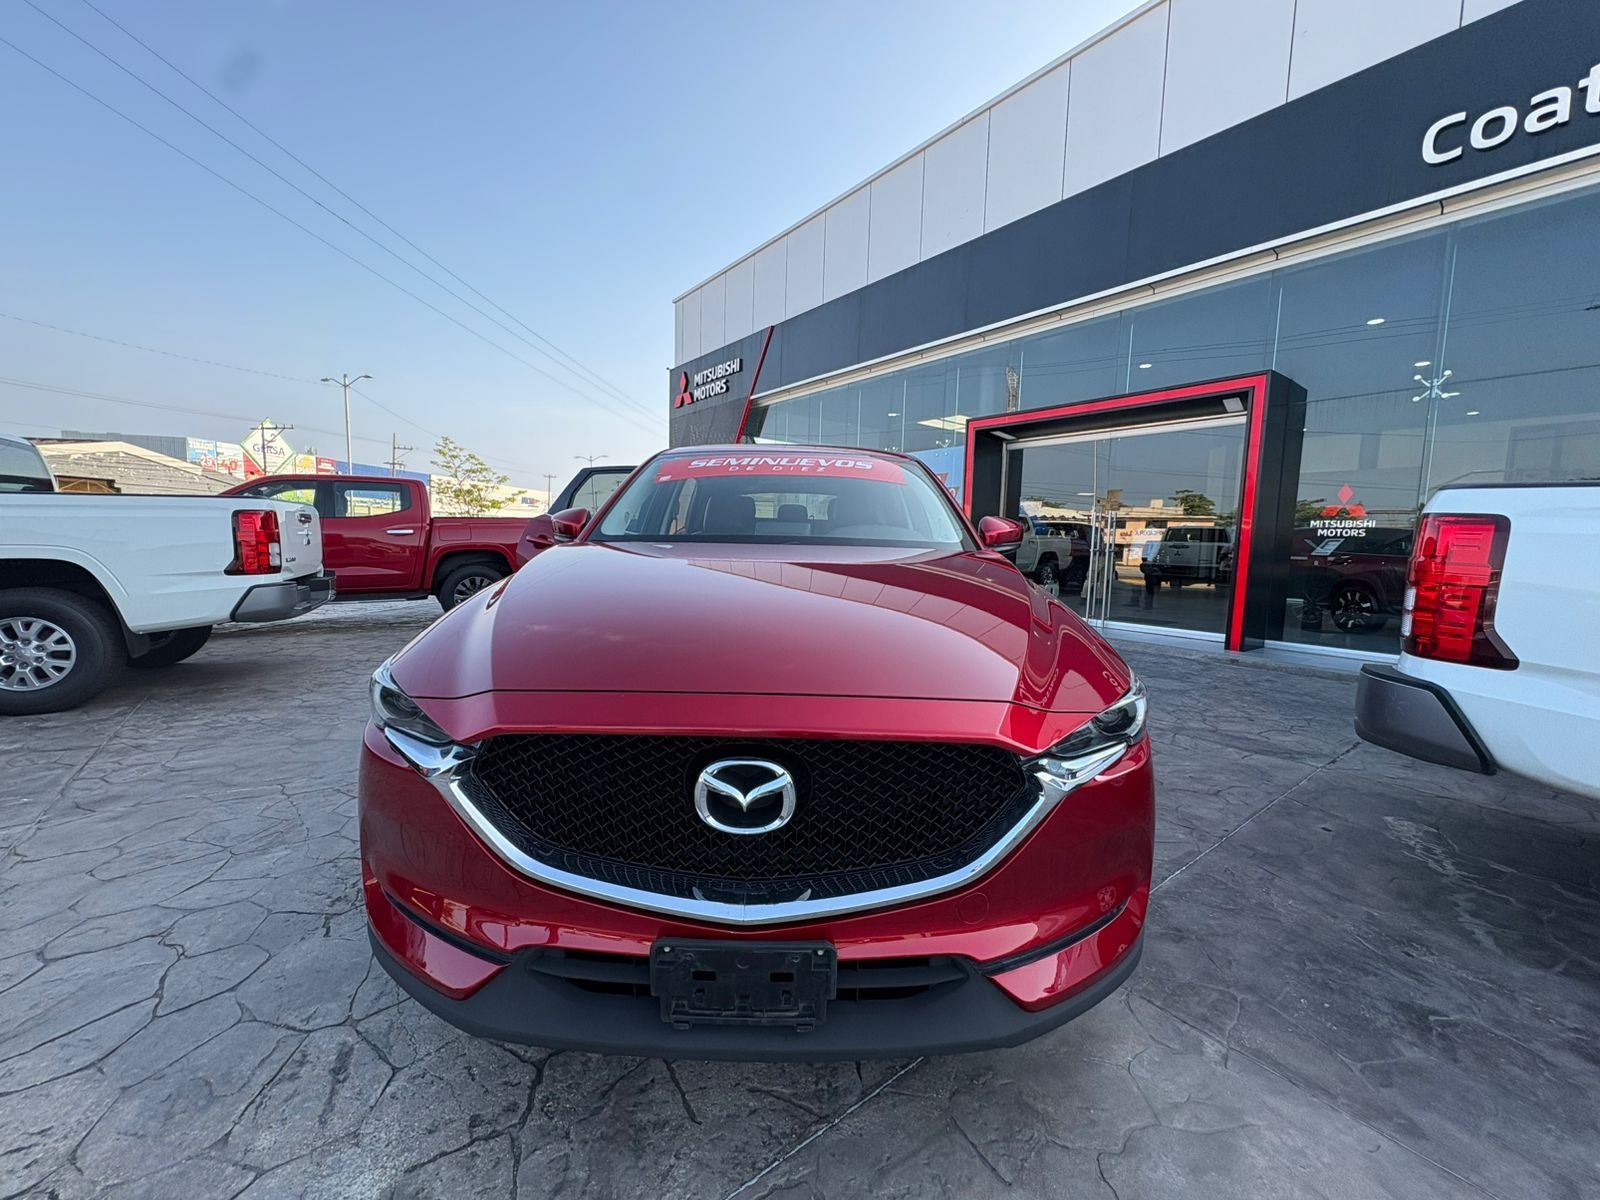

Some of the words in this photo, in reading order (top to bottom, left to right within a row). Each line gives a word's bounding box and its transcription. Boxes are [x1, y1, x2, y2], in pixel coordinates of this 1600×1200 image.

[694, 358, 740, 386] MITSUBISHI
[694, 379, 727, 402] MOTORS
[688, 457, 873, 470] SEMINUEVOS
[1310, 520, 1376, 528] MITSUBISHI
[1317, 529, 1366, 537] MOTORS
